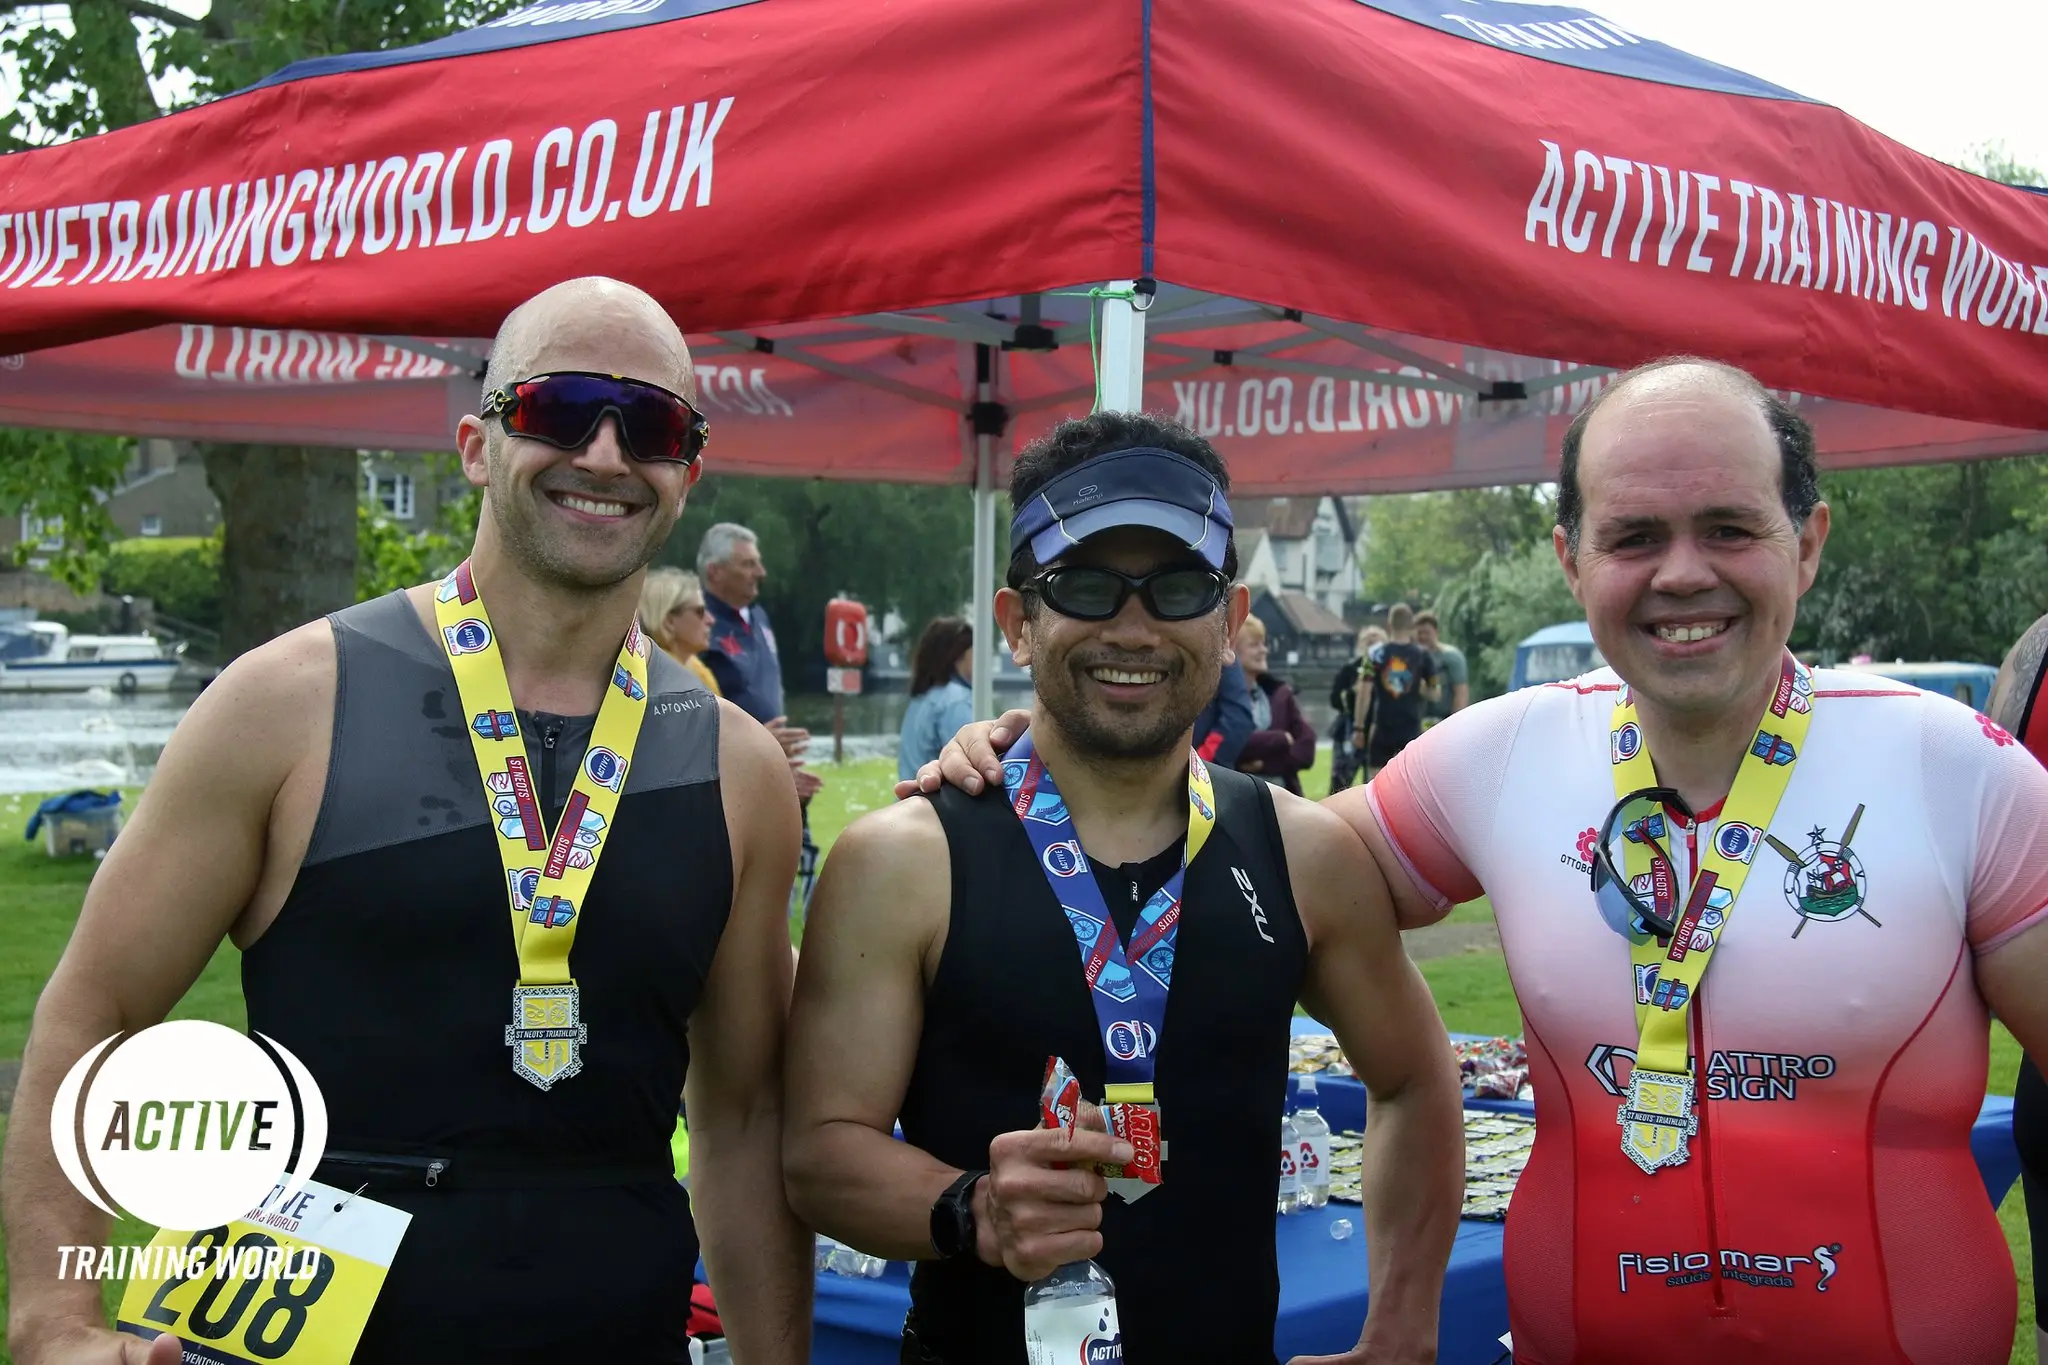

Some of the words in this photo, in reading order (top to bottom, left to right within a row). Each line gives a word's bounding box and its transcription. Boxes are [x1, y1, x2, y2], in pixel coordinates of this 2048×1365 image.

[1525, 138, 1720, 273] ACTIVE
[1729, 179, 1938, 311] TRAINING
[510, 759, 523, 771] ST
[597, 754, 611, 778] ACTIVE
[513, 772, 531, 801] NEOTS'
[552, 834, 570, 865] NEOTS'
[1727, 829, 1742, 853] ACTIVE
[549, 863, 560, 876] ST
[1054, 850, 1070, 870] ACTIVE
[1654, 860, 1666, 870] ST
[1230, 866, 1275, 943] 2XU
[1676, 917, 1695, 948] NEOTS'
[1672, 945, 1684, 959] ST
[515, 1031, 524, 1039] ST
[545, 1029, 578, 1038] TRIATHLON
[1116, 1029, 1129, 1052] ACTIVE
[1688, 1050, 1835, 1079] ATTRO
[1706, 1073, 1797, 1101] SIGN
[1655, 1115, 1688, 1127] TRIATHLON
[266, 1212, 299, 1233] WORLD
[1721, 1268, 1794, 1288] integrada
[143, 1225, 335, 1359] 208
[1091, 1343, 1122, 1362] ACTIV
